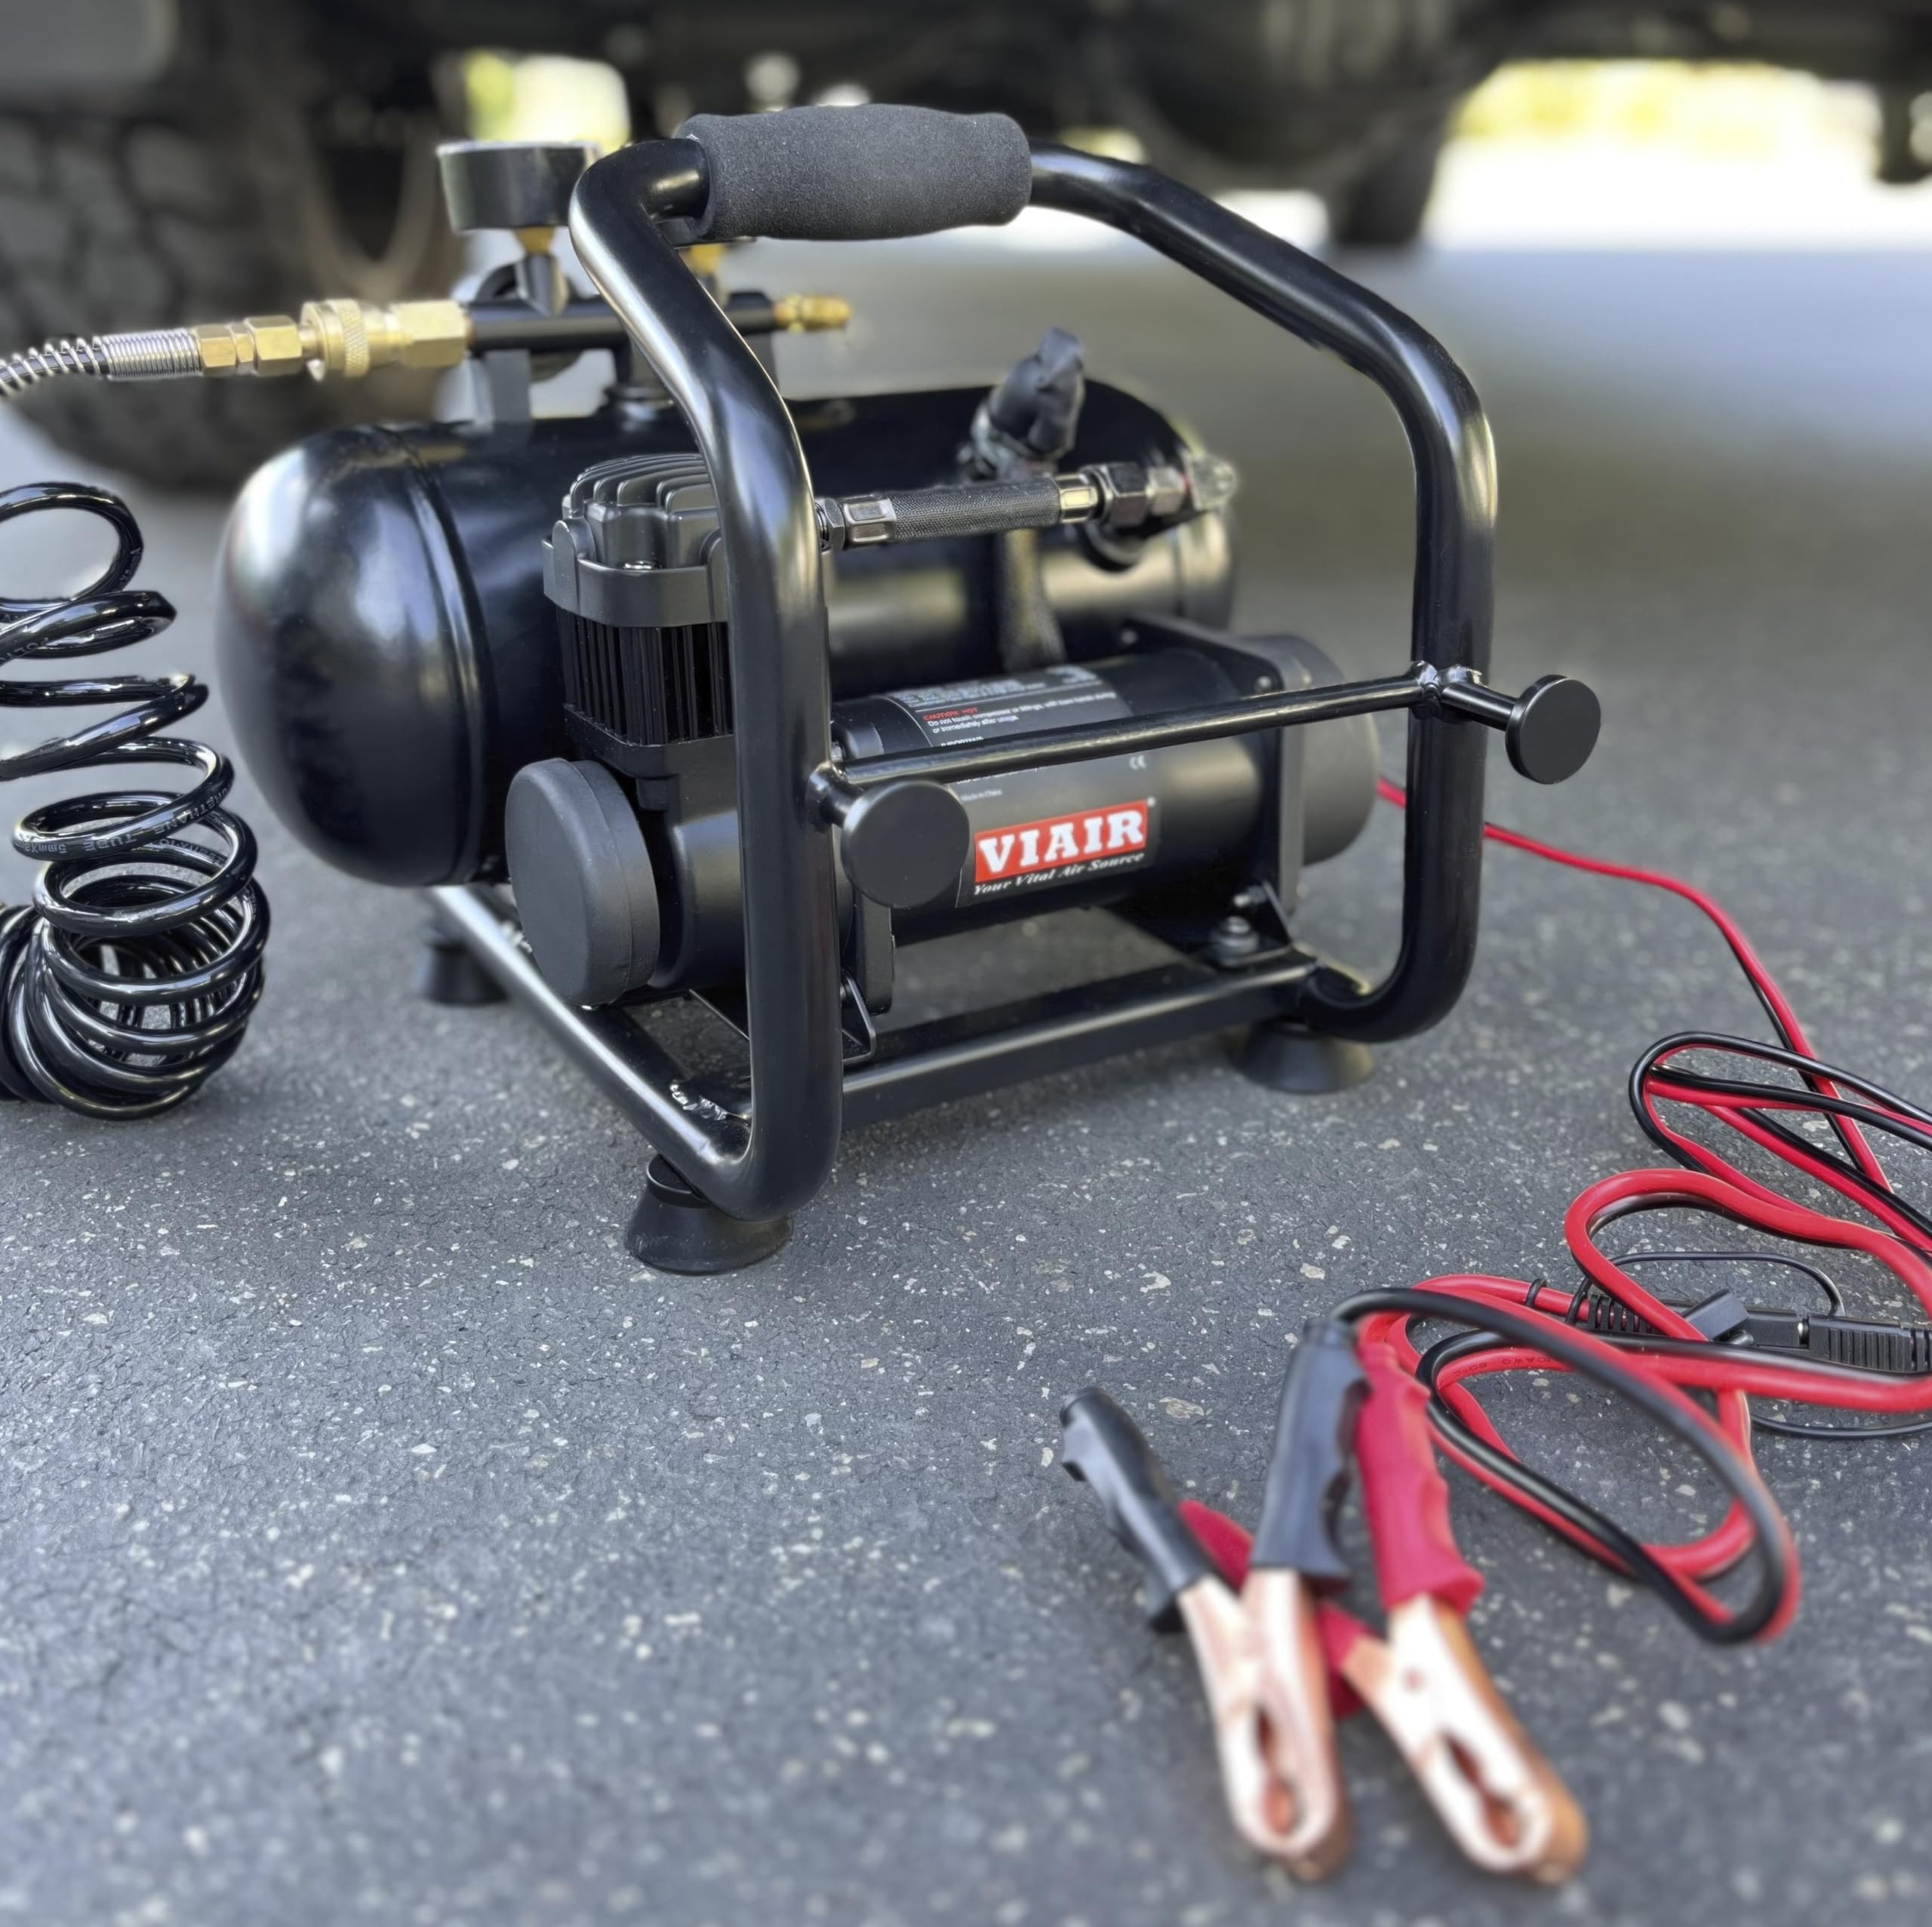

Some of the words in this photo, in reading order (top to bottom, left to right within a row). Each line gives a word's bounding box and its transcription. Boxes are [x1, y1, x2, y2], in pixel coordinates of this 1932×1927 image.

[83, 834, 137, 852] TUBE
[980, 810, 1143, 874] VIAIR
[974, 881, 1011, 895] Your
[1016, 869, 1056, 887] Vital
[1058, 863, 1086, 877] Air
[1088, 853, 1144, 871] Source
